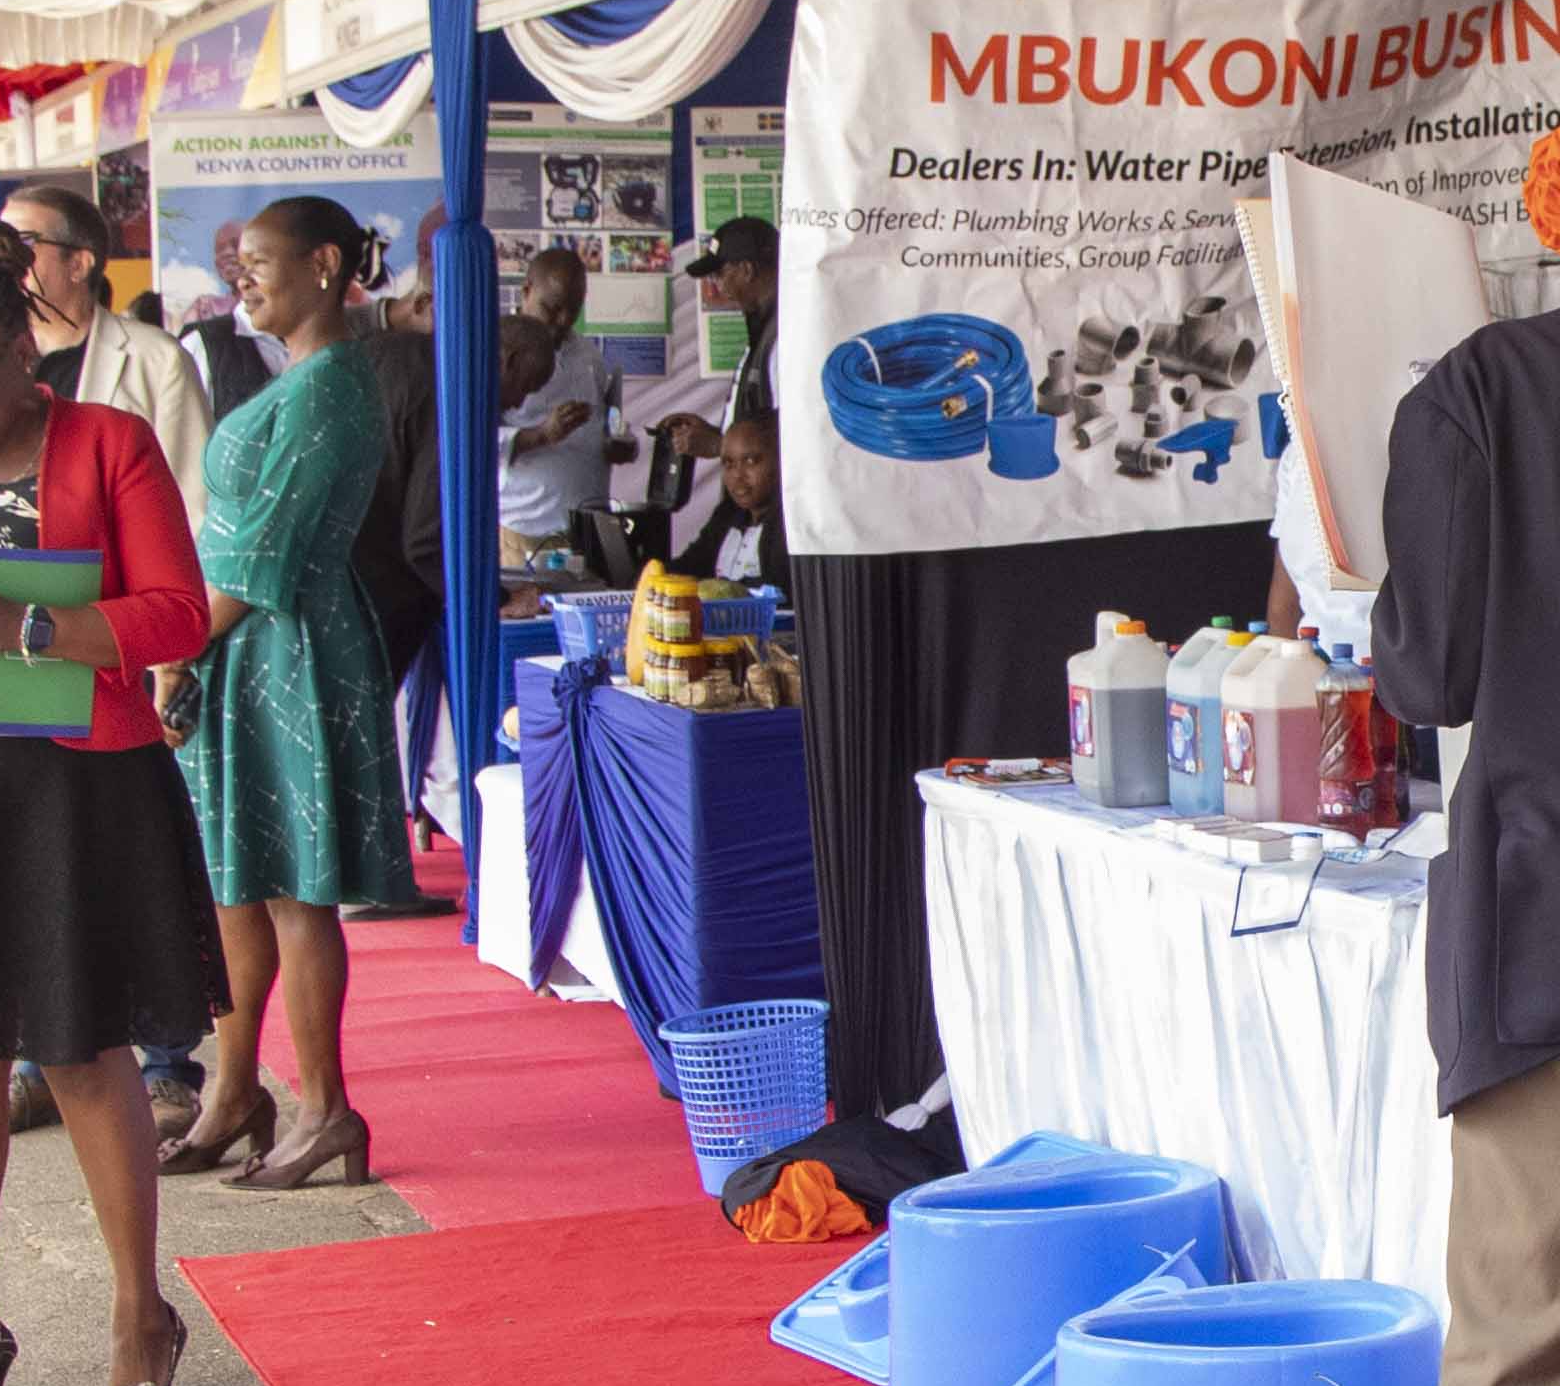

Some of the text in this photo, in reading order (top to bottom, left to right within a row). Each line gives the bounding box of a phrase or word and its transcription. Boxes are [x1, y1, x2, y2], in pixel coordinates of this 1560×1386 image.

[929, 28, 1360, 109] MBUKONI
[173, 133, 329, 154] ACTION AGAINST
[195, 152, 408, 174] KENYA COUNTRY OFFICE
[889, 146, 1023, 183] Dealers
[1032, 150, 1077, 182] In:
[1085, 149, 1191, 183] Water
[1199, 149, 1269, 186] Pipe
[1397, 175, 1426, 197] of
[844, 208, 1178, 236] Offered: Plumbing Works &
[901, 245, 1150, 273] Communities, Group
